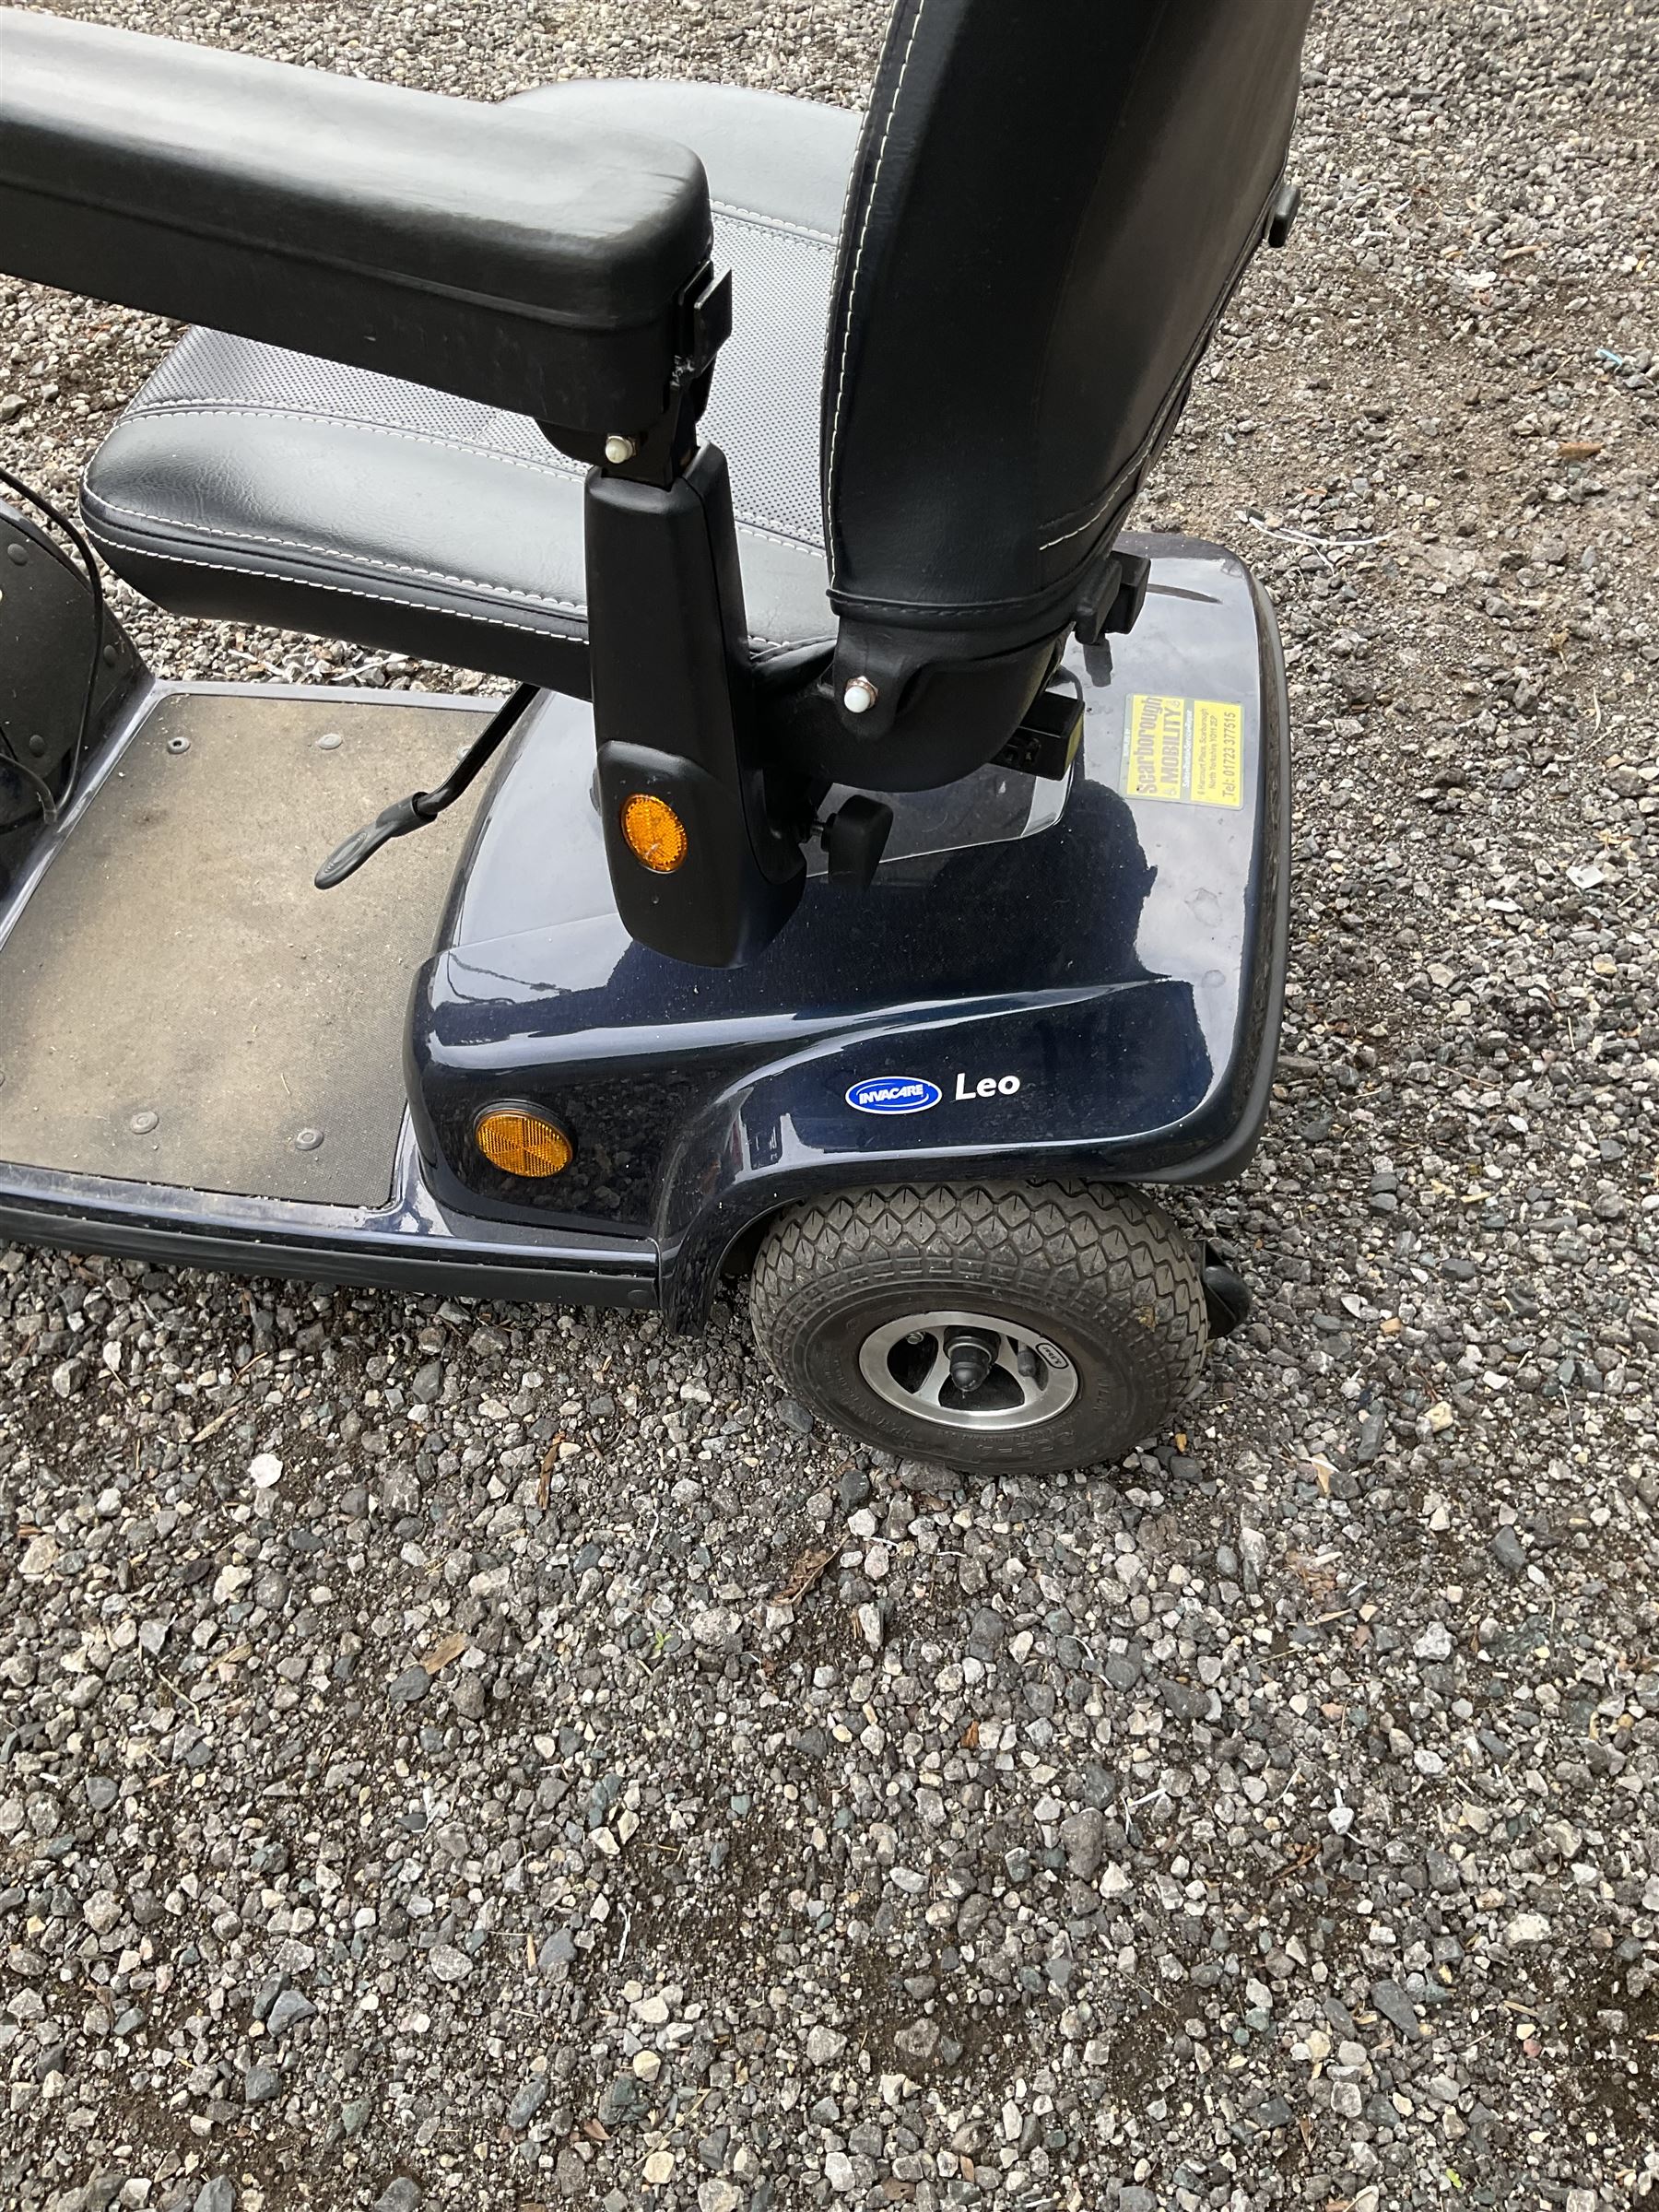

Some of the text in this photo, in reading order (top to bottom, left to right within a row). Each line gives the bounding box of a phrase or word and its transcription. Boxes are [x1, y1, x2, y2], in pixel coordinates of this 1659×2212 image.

[1133, 696, 1163, 794] Scarborough
[1160, 706, 1182, 784] MOBILITY
[1198, 708, 1209, 744] Scarborough
[1222, 712, 1236, 797] Tel: 01723 377515
[859, 1084, 924, 1105] INVACARE
[955, 1072, 1020, 1100] Leo
